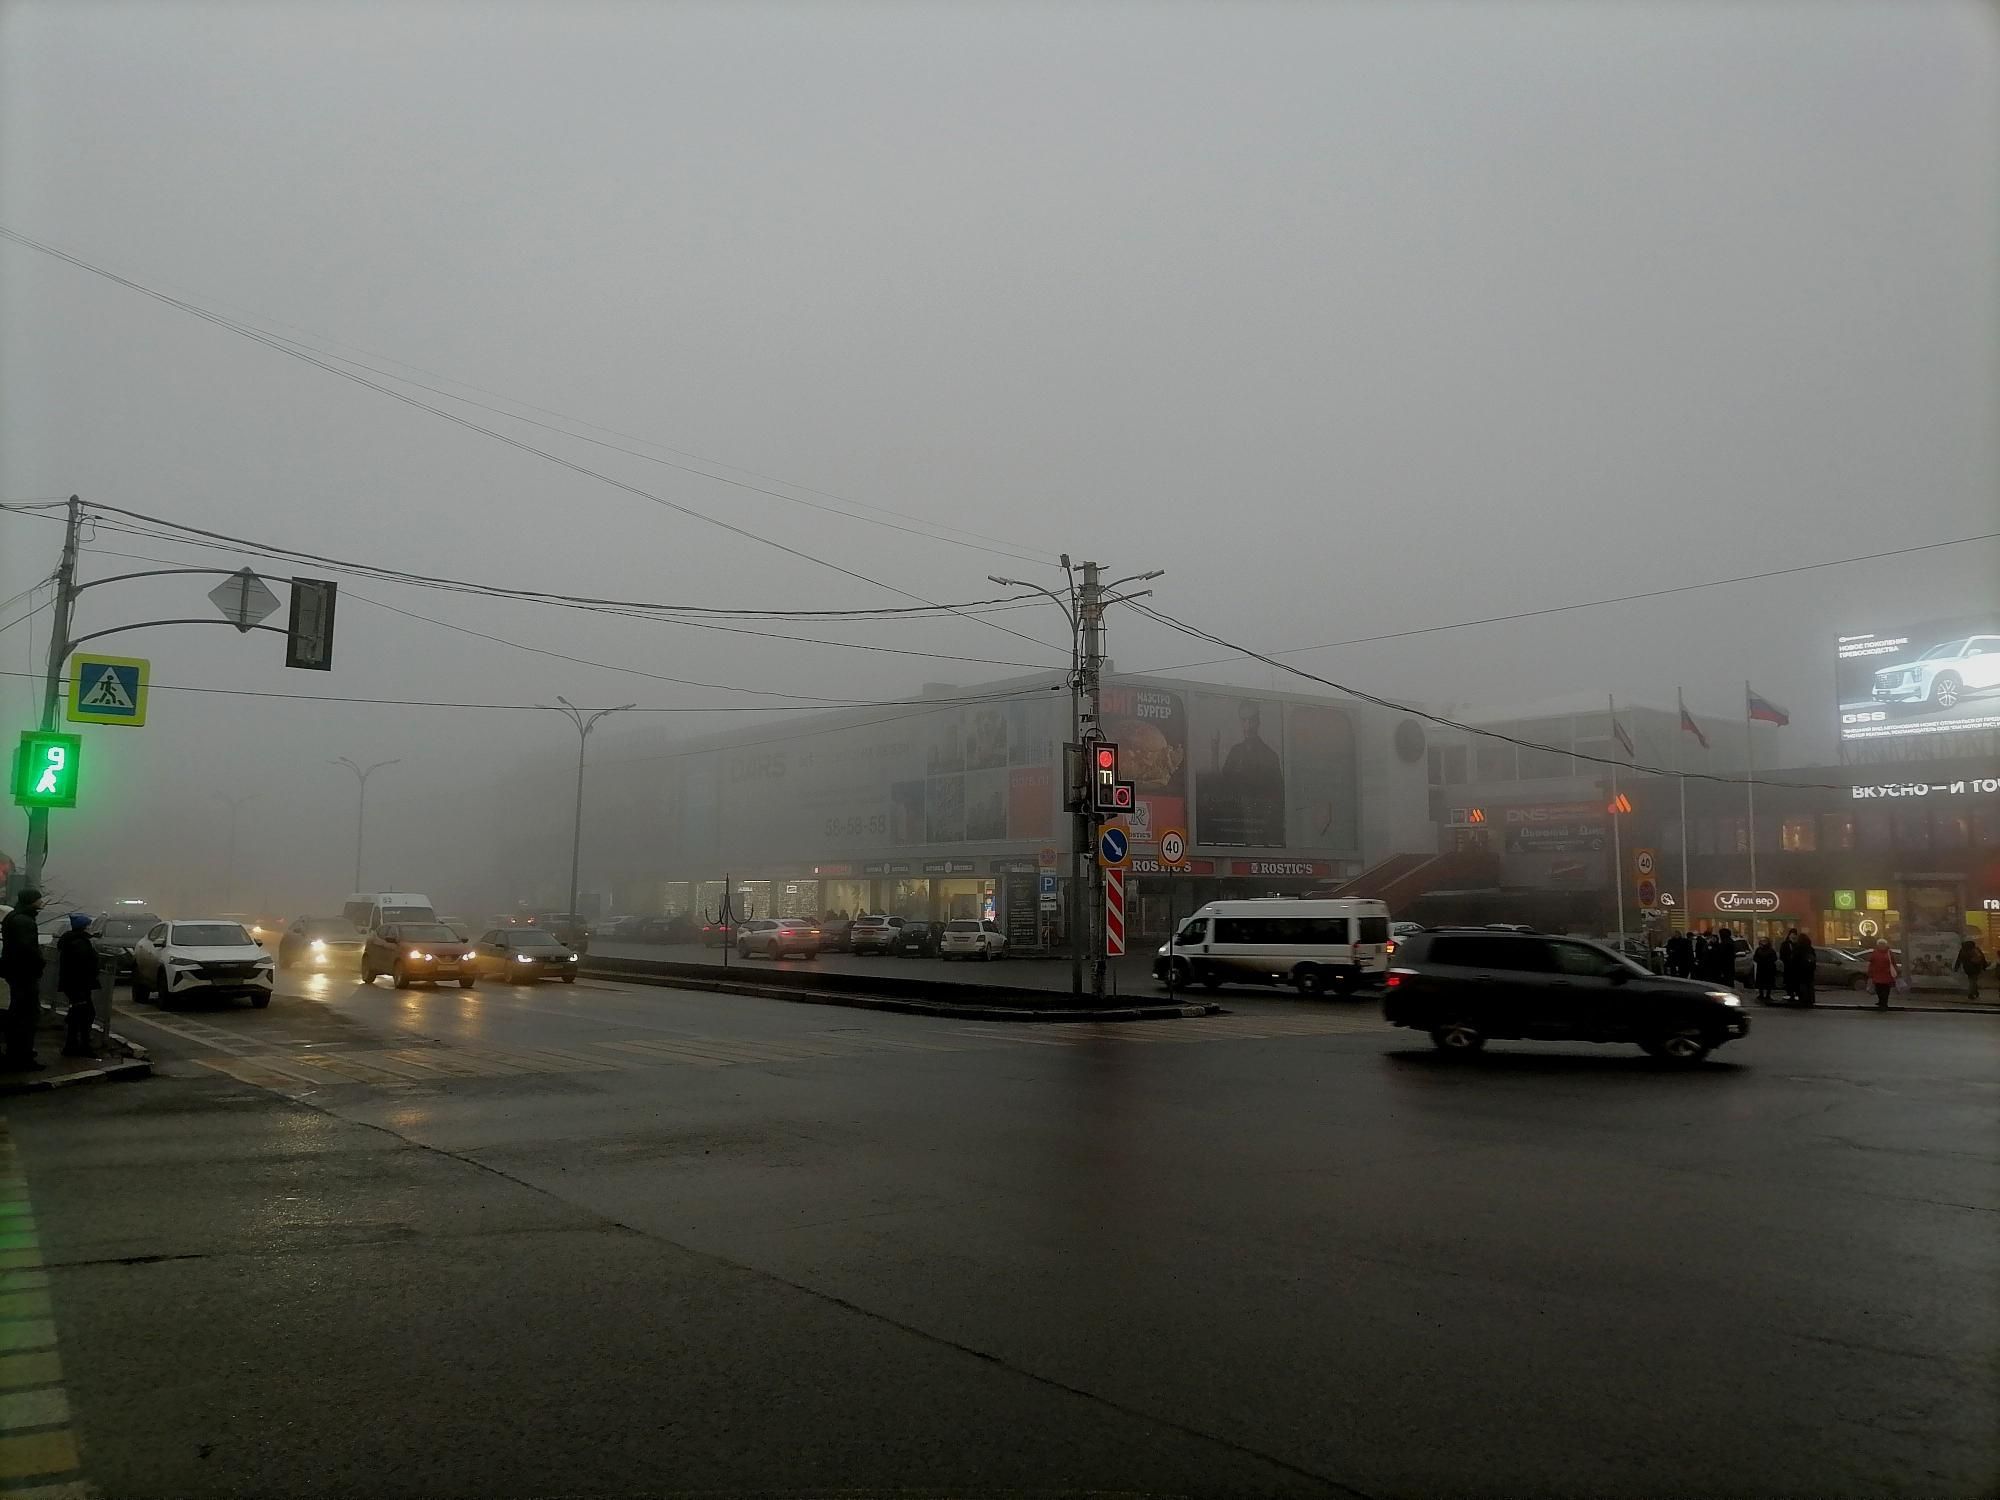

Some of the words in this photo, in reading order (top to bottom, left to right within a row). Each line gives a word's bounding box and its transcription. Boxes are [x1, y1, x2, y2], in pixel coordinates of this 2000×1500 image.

[1137, 703, 1172, 719] БУРГЕР
[1842, 711, 1887, 724] GS8
[47, 746, 65, 771] 9
[1852, 783, 1929, 799] ВКУСНО
[1950, 781, 1965, 794] И
[824, 815, 887, 838] 58-58-58
[1165, 840, 1179, 855] 40
[1260, 862, 1313, 875] ROSTIC'S
[1640, 857, 1651, 868] 40
[1044, 877, 1054, 891] P
